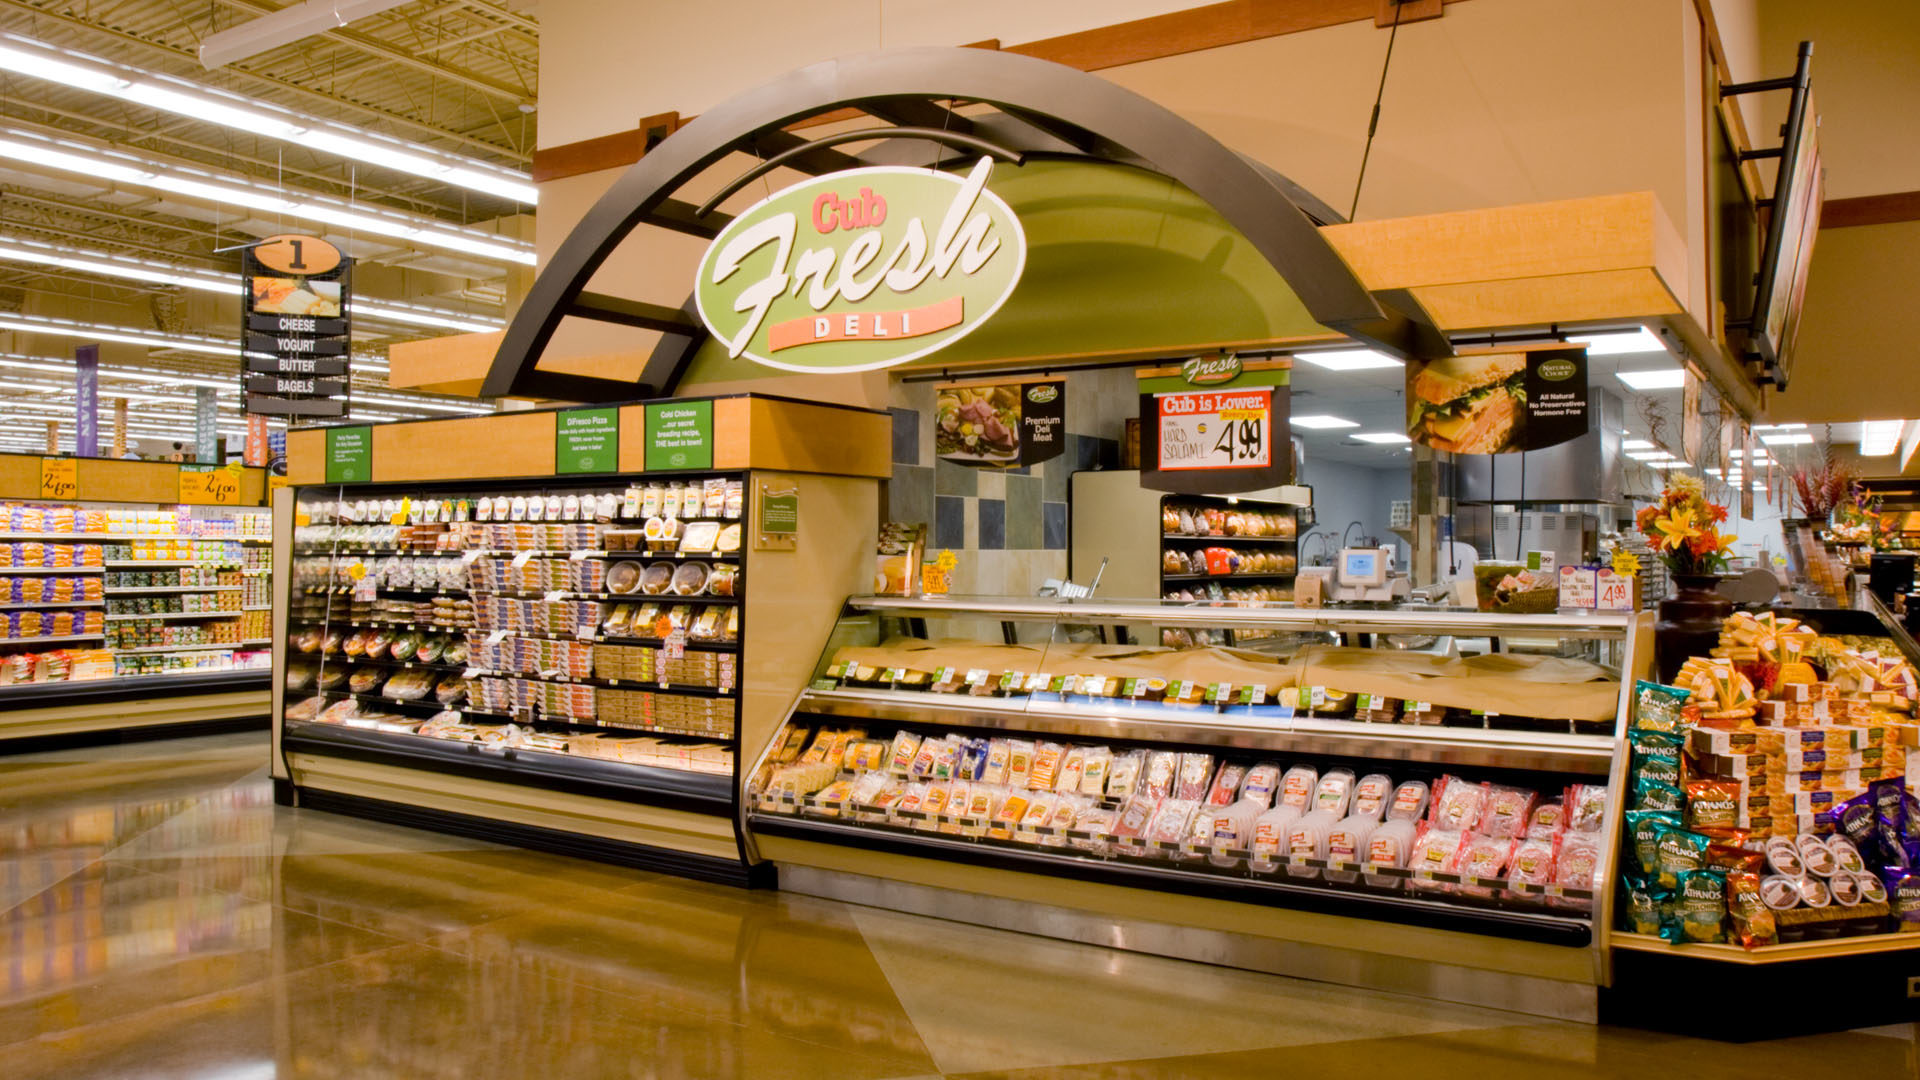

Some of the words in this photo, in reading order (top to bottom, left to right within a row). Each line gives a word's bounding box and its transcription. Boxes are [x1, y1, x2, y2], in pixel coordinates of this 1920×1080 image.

[812, 186, 887, 233] Cub
[289, 240, 307, 269] 1
[712, 155, 1002, 359] Fresh
[279, 318, 315, 331] CHEESE
[815, 312, 910, 338] DELI
[277, 339, 315, 351] YOGURT
[279, 358, 315, 372] BUTTER
[1184, 352, 1239, 383] Fresh
[277, 380, 314, 393] BAGELS
[1163, 397, 1195, 413] Cub
[1200, 395, 1212, 411] is
[1215, 395, 1264, 410] Lower.
[1025, 416, 1060, 425] Premium
[1035, 425, 1051, 433] Deli
[1033, 433, 1053, 442] Meat
